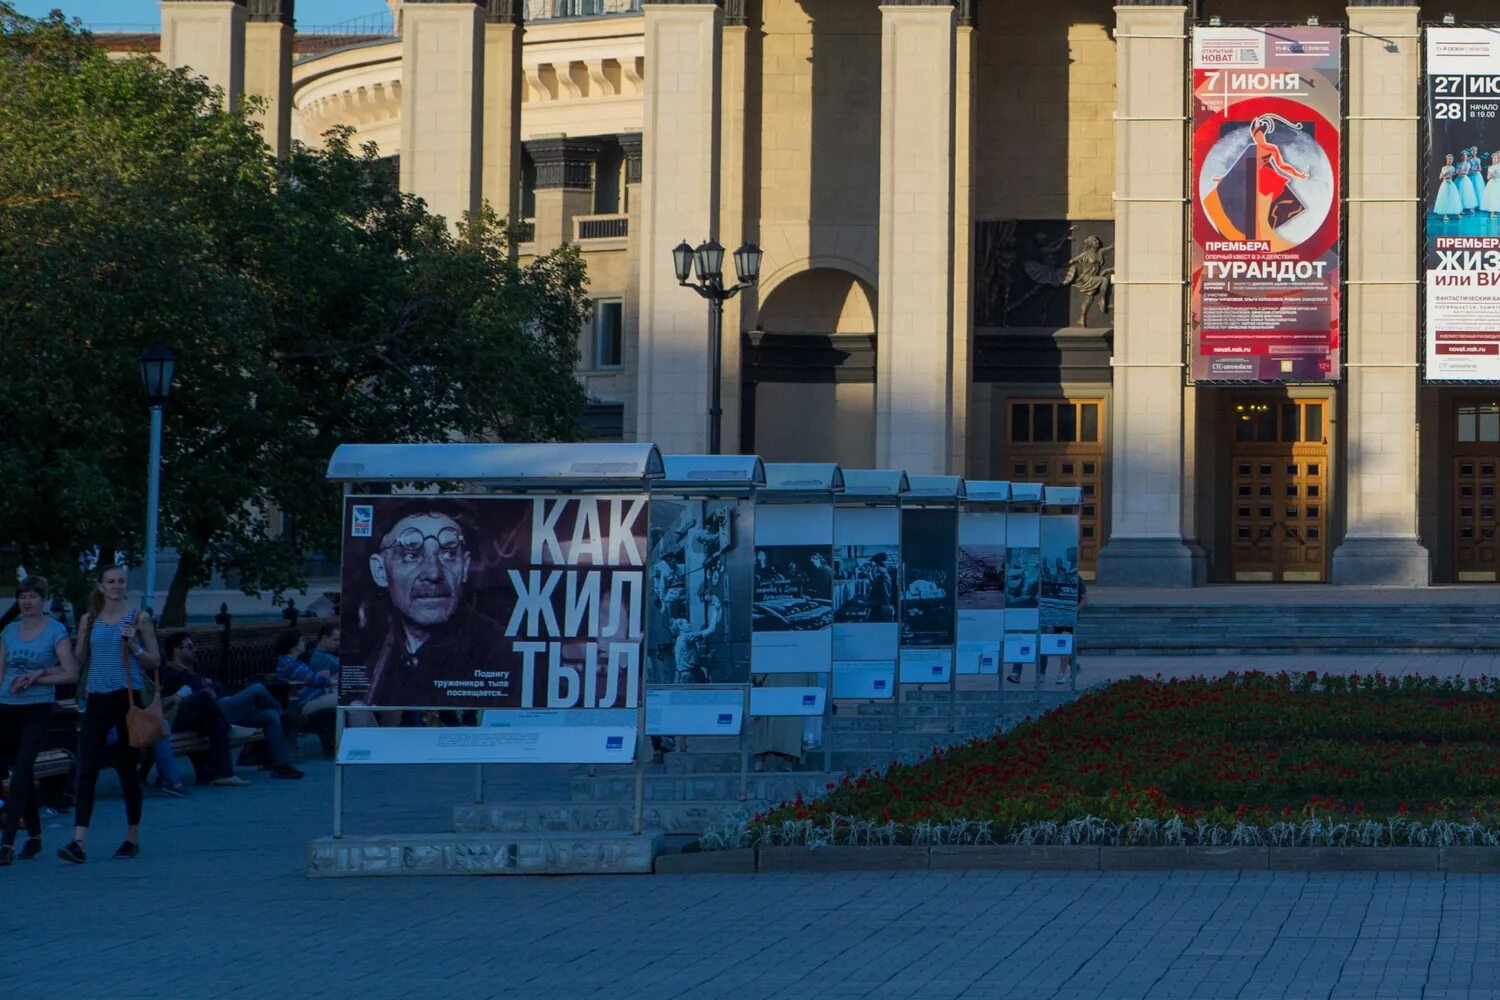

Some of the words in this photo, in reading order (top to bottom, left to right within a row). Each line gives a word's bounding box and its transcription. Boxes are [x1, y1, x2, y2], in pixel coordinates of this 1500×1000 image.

[1201, 54, 1233, 62] НОВАТ
[1204, 71, 1220, 91] 7
[1231, 73, 1300, 90] ИЮНЯ
[1434, 76, 1461, 93] 27
[1434, 102, 1461, 120] 28
[1205, 241, 1269, 252] ПРЕМЬЕРА
[1203, 261, 1327, 282] ТУРАНДОТ
[1435, 275, 1471, 286] или
[530, 497, 645, 567] КАК
[504, 569, 644, 639] ЖИЛ
[474, 669, 510, 679] Подвигу
[512, 641, 643, 709] ТЫЛ
[433, 680, 484, 688] тружеников
[446, 689, 509, 697] посвящается...
